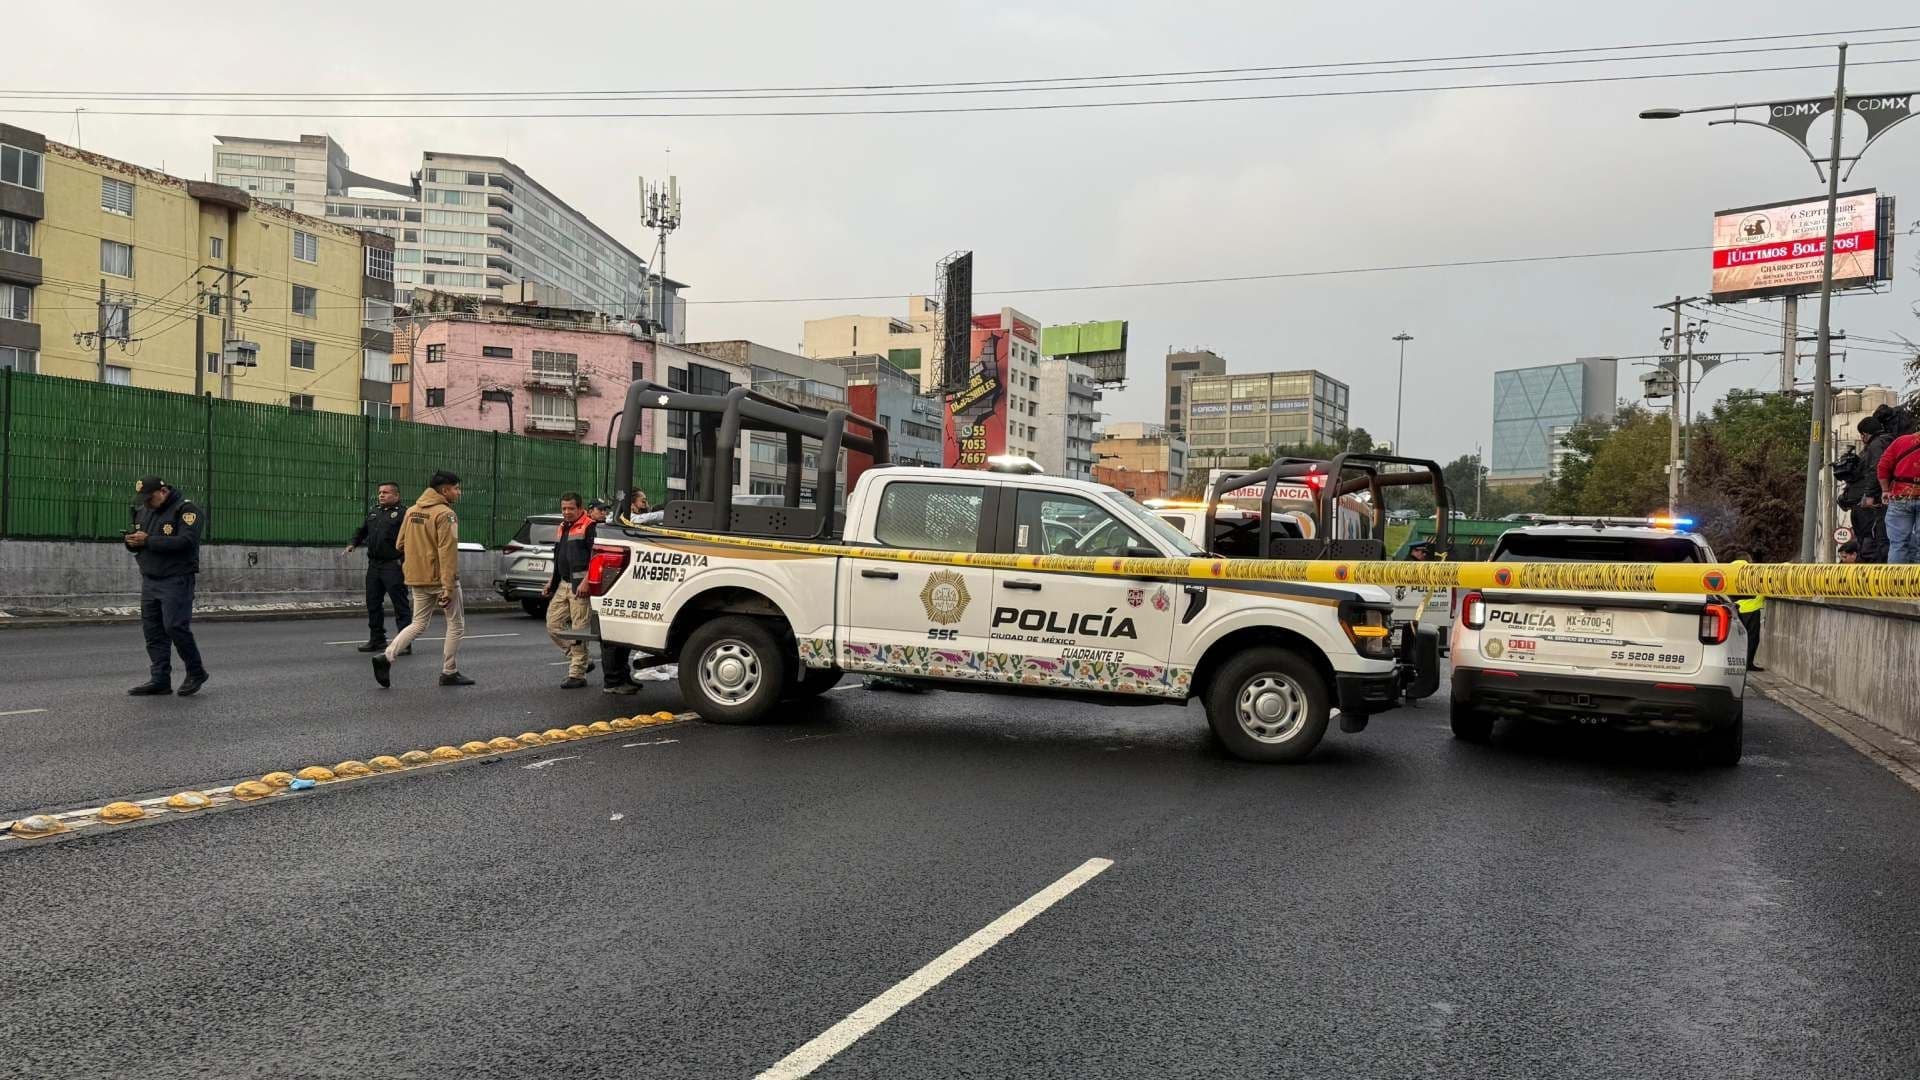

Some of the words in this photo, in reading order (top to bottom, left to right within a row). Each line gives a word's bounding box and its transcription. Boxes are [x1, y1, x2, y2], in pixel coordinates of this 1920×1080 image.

[1772, 102, 1821, 118] CDMX
[1857, 97, 1907, 111] CDMX
[1790, 211, 1797, 219] 6
[972, 425, 986, 436] 55
[961, 439, 986, 450] 7053
[960, 453, 986, 464] 7667
[1227, 486, 1309, 499] AMBUANCIA
[635, 551, 709, 567] TACUBAYA
[602, 598, 613, 606] 55
[615, 599, 625, 608] 52
[627, 600, 637, 609] 08
[640, 601, 650, 610] 98
[652, 602, 661, 611] 98
[992, 606, 1138, 640] POLICÍA
[1489, 609, 1557, 628] POLICÍA
[928, 629, 959, 641] SSC
[991, 632, 1023, 641] CIUDAD
[1027, 635, 1039, 643] DE
[1042, 636, 1076, 646] MÉXICO
[1509, 640, 1535, 649] 911
[1061, 647, 1113, 662] CUADRANTE
[1115, 651, 1125, 663] 12
[1611, 651, 1625, 660] 55
[1628, 652, 1655, 661] 5208
[1658, 654, 1685, 664] 9898
